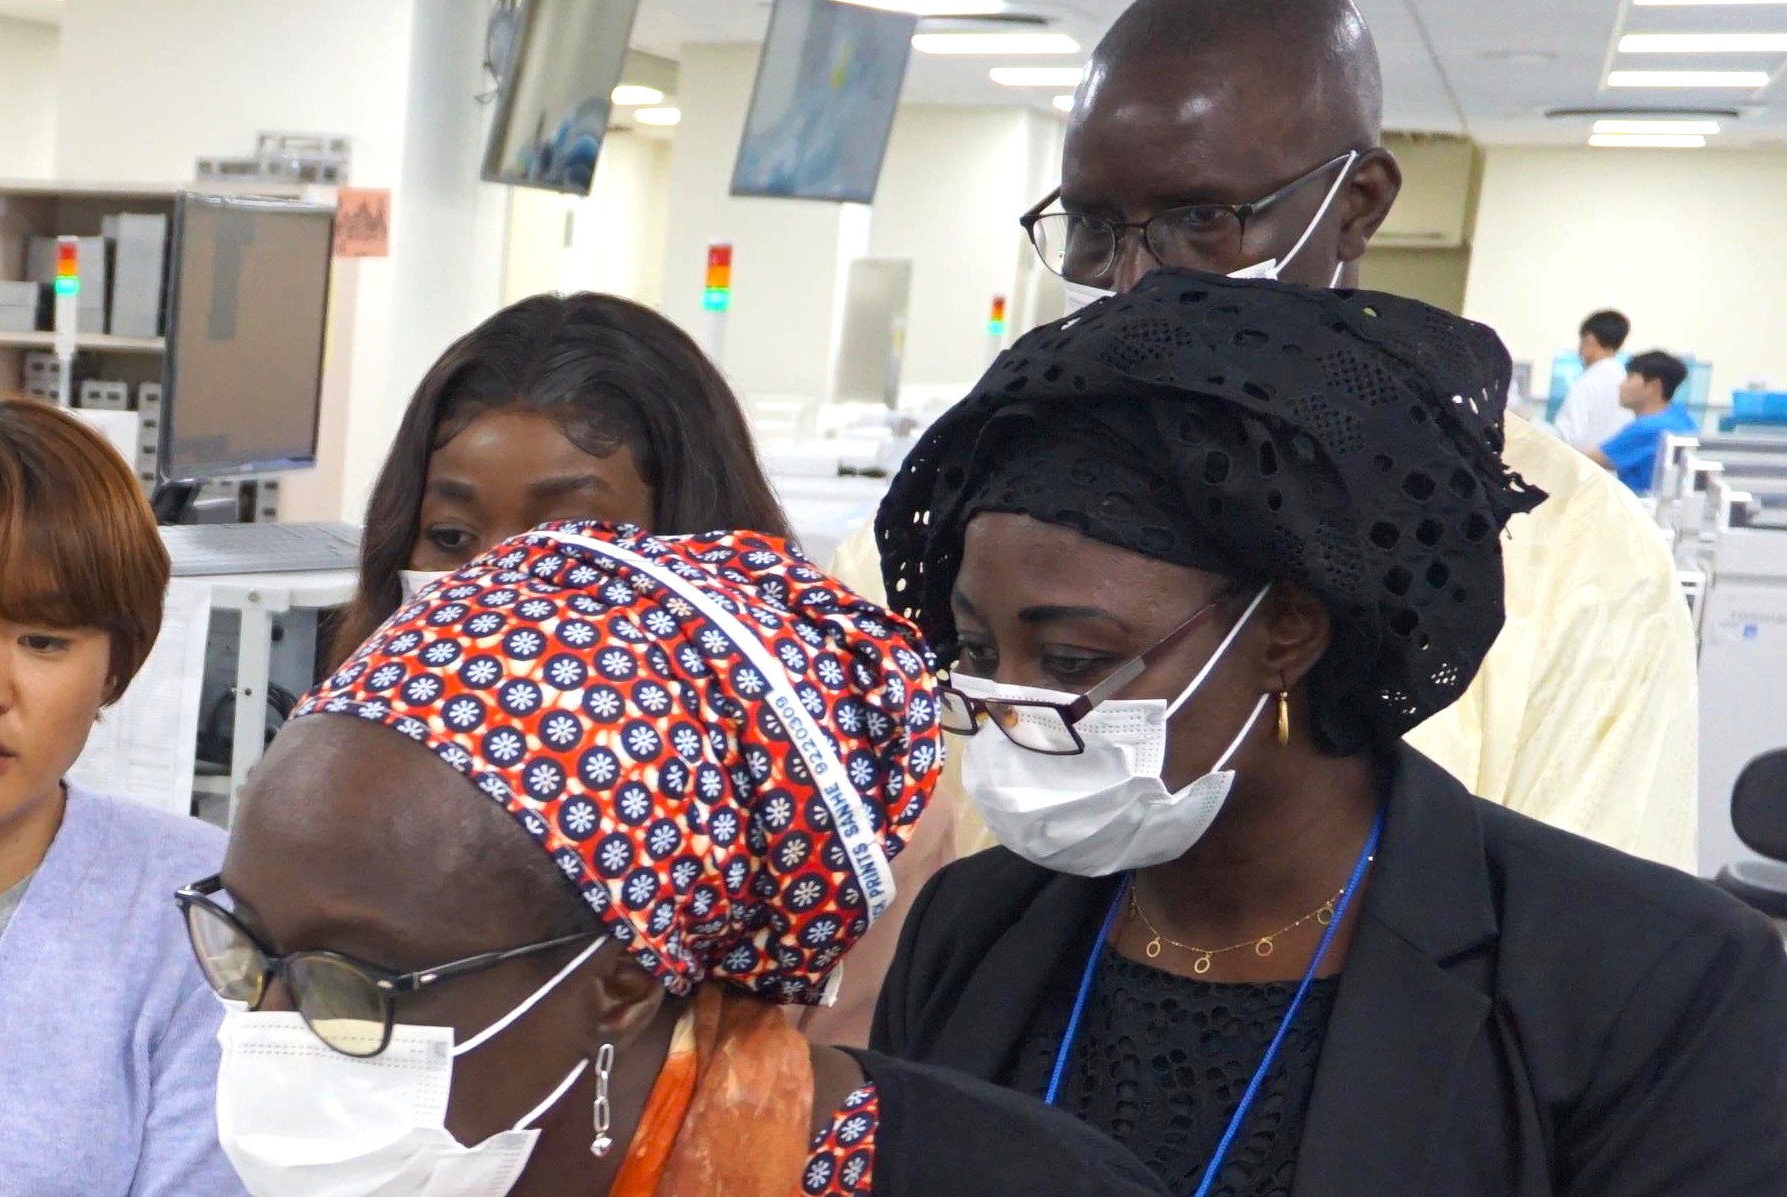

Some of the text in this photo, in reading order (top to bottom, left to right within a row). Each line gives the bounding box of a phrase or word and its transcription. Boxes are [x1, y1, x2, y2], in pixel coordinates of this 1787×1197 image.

[774, 695, 827, 775] 9220309
[825, 781, 860, 837] SANHE
[853, 842, 885, 898] PRINTS
